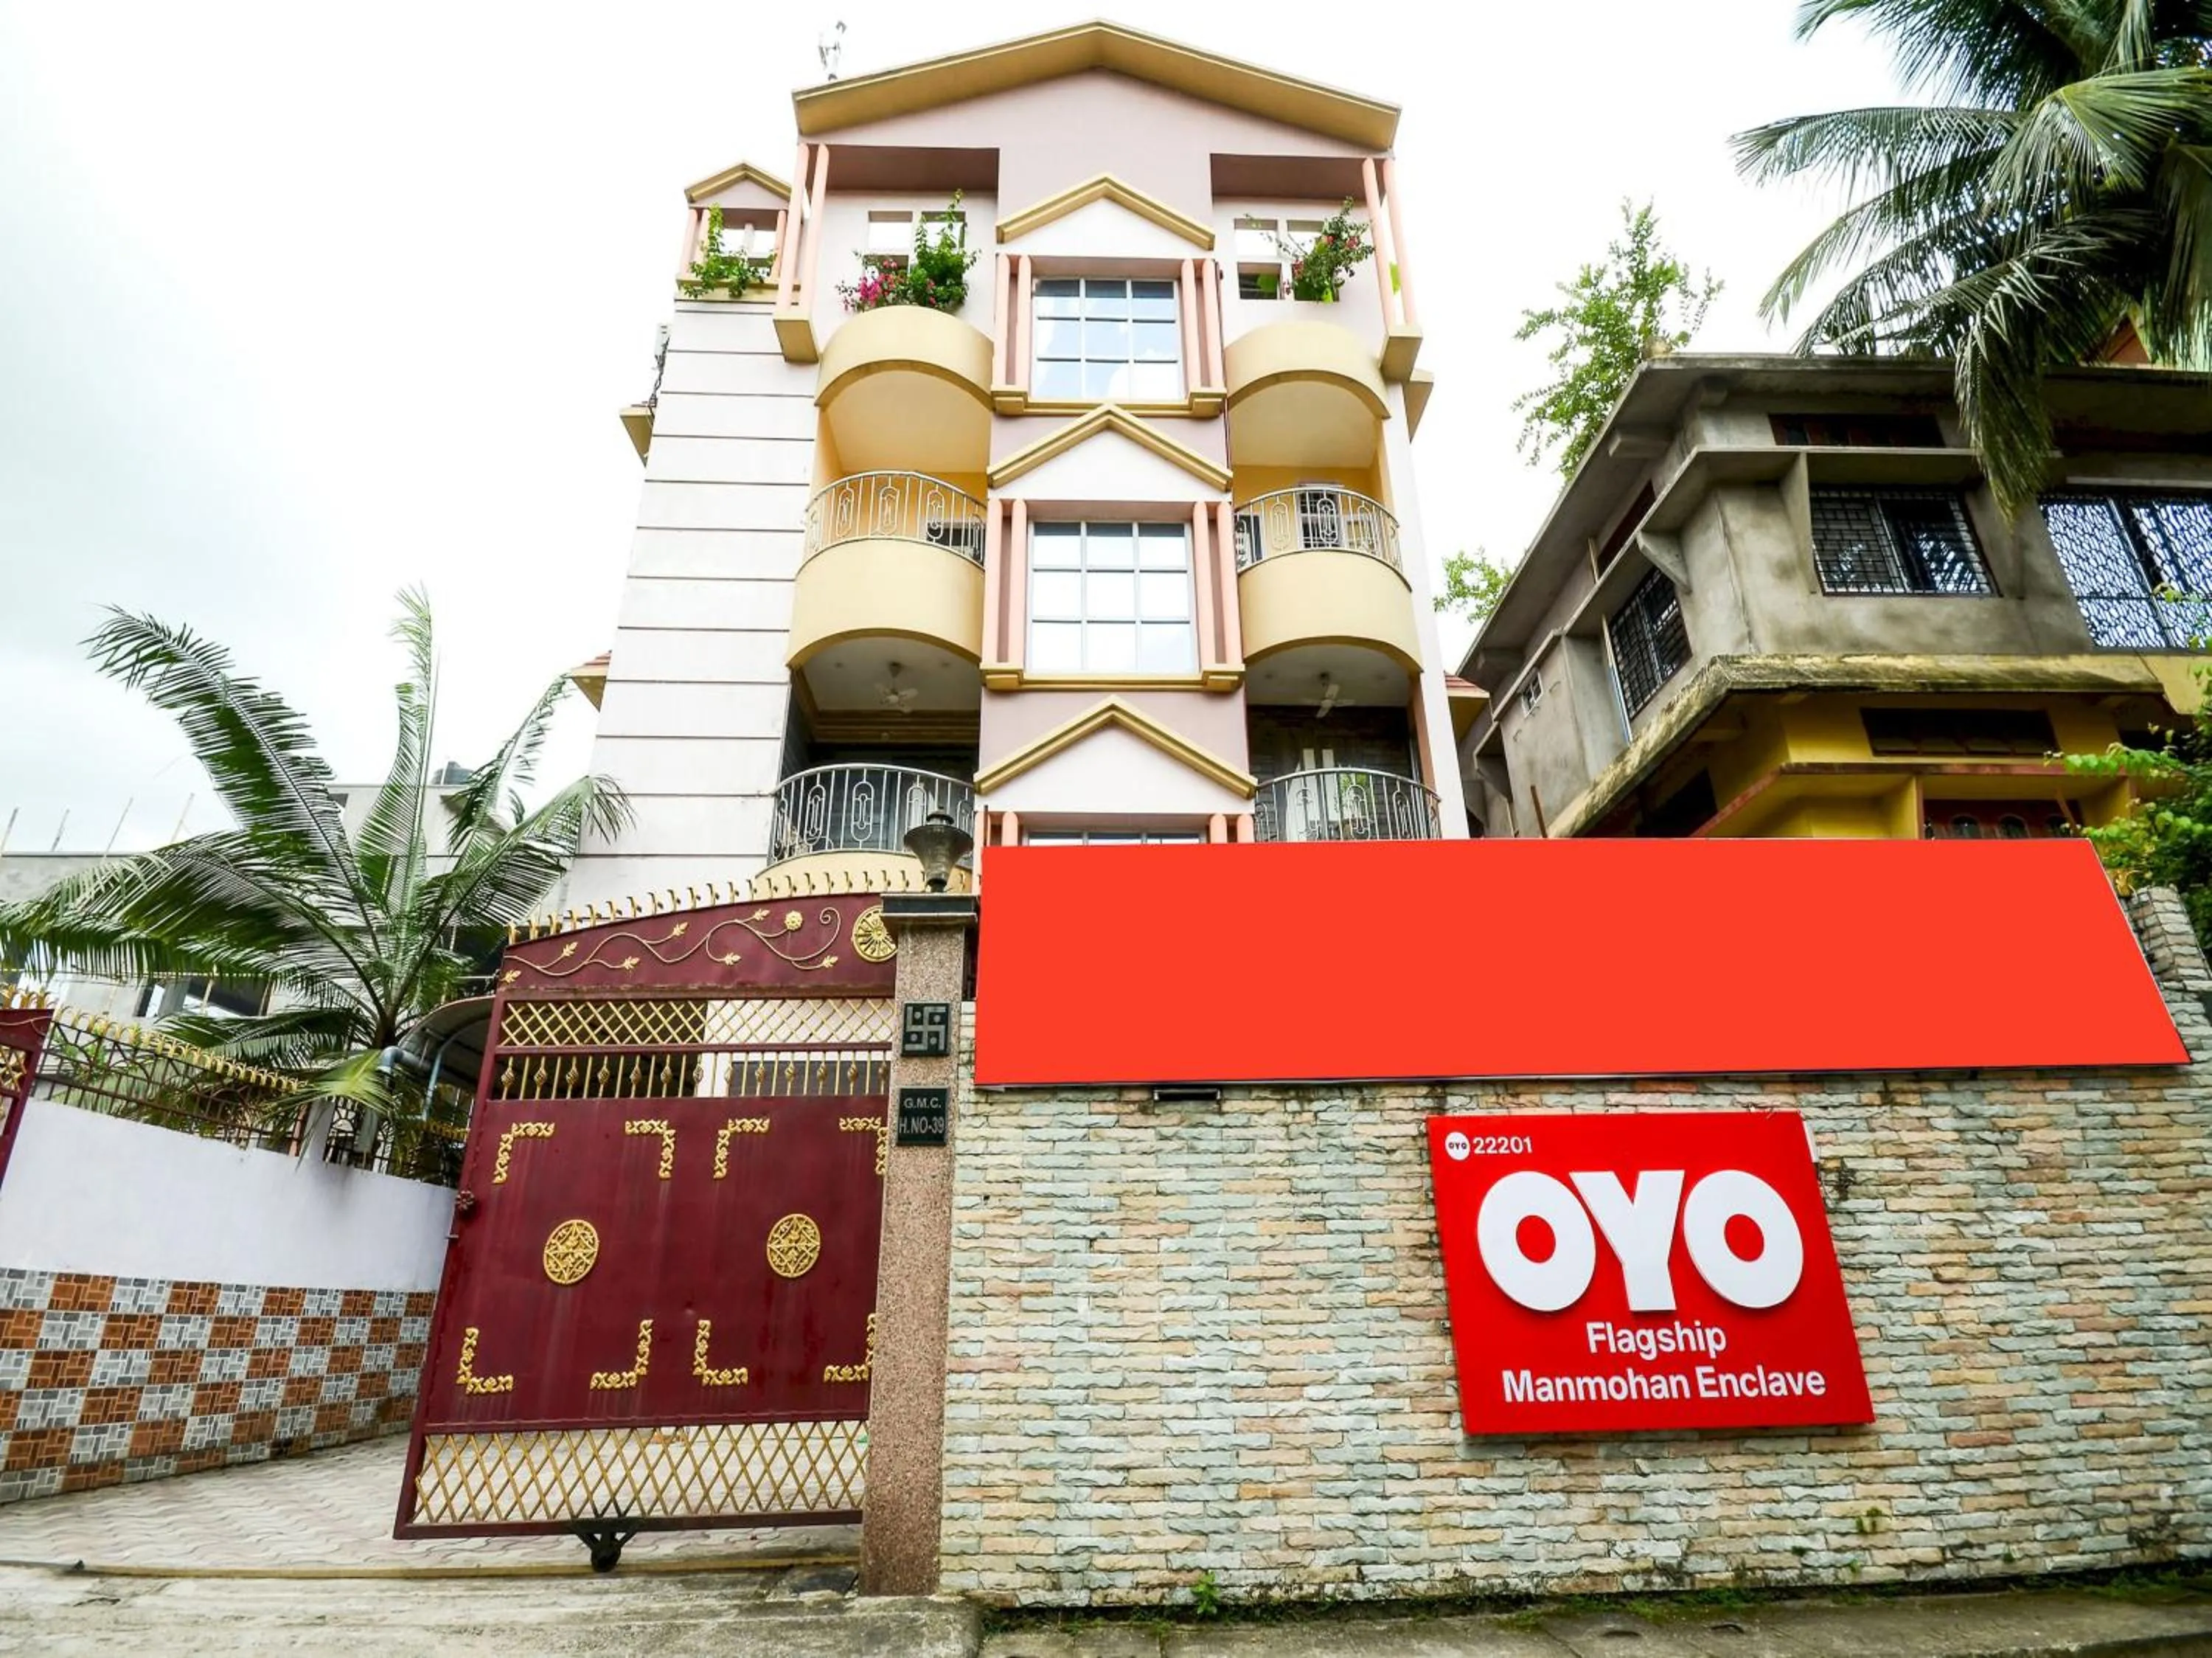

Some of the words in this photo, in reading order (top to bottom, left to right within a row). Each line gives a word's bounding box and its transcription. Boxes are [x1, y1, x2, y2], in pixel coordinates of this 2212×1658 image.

[904, 1097, 942, 1108] G.M.C.
[899, 1117, 945, 1134] H.NO-39
[1448, 1142, 1467, 1151] OYO
[1473, 1137, 1533, 1154] 22201
[1477, 1169, 1804, 1312] OYO
[1586, 1320, 1727, 1361] Flagship
[1502, 1367, 1691, 1403] Manmohan
[1695, 1365, 1826, 1398] Enclave
